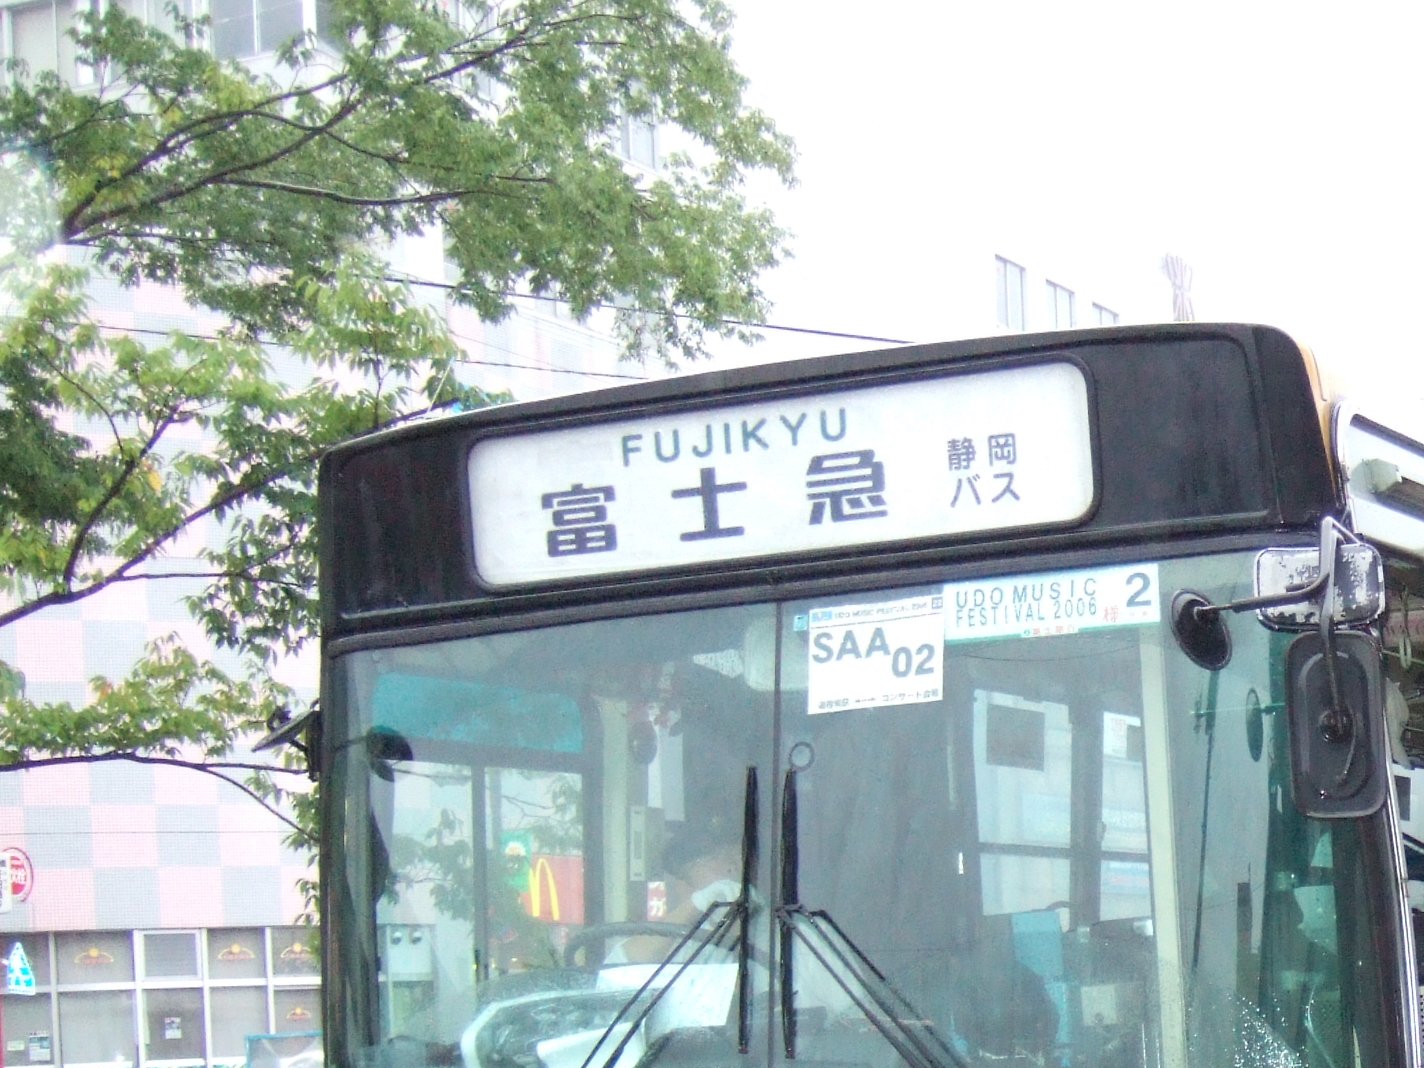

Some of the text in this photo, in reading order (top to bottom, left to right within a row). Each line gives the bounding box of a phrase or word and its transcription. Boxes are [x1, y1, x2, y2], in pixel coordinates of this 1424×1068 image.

[620, 407, 849, 467] FUJIKYU
[946, 431, 1018, 472] 静岡
[540, 447, 888, 558] 富士急
[949, 471, 1021, 509] バス
[956, 587, 1004, 609] UDO
[1012, 577, 1097, 605] MUSIC
[1125, 572, 1152, 608] 2
[956, 603, 1046, 628] FESTIVAL
[1053, 597, 1097, 620] 2006
[812, 627, 891, 664] SAA
[891, 643, 935, 678] 02
